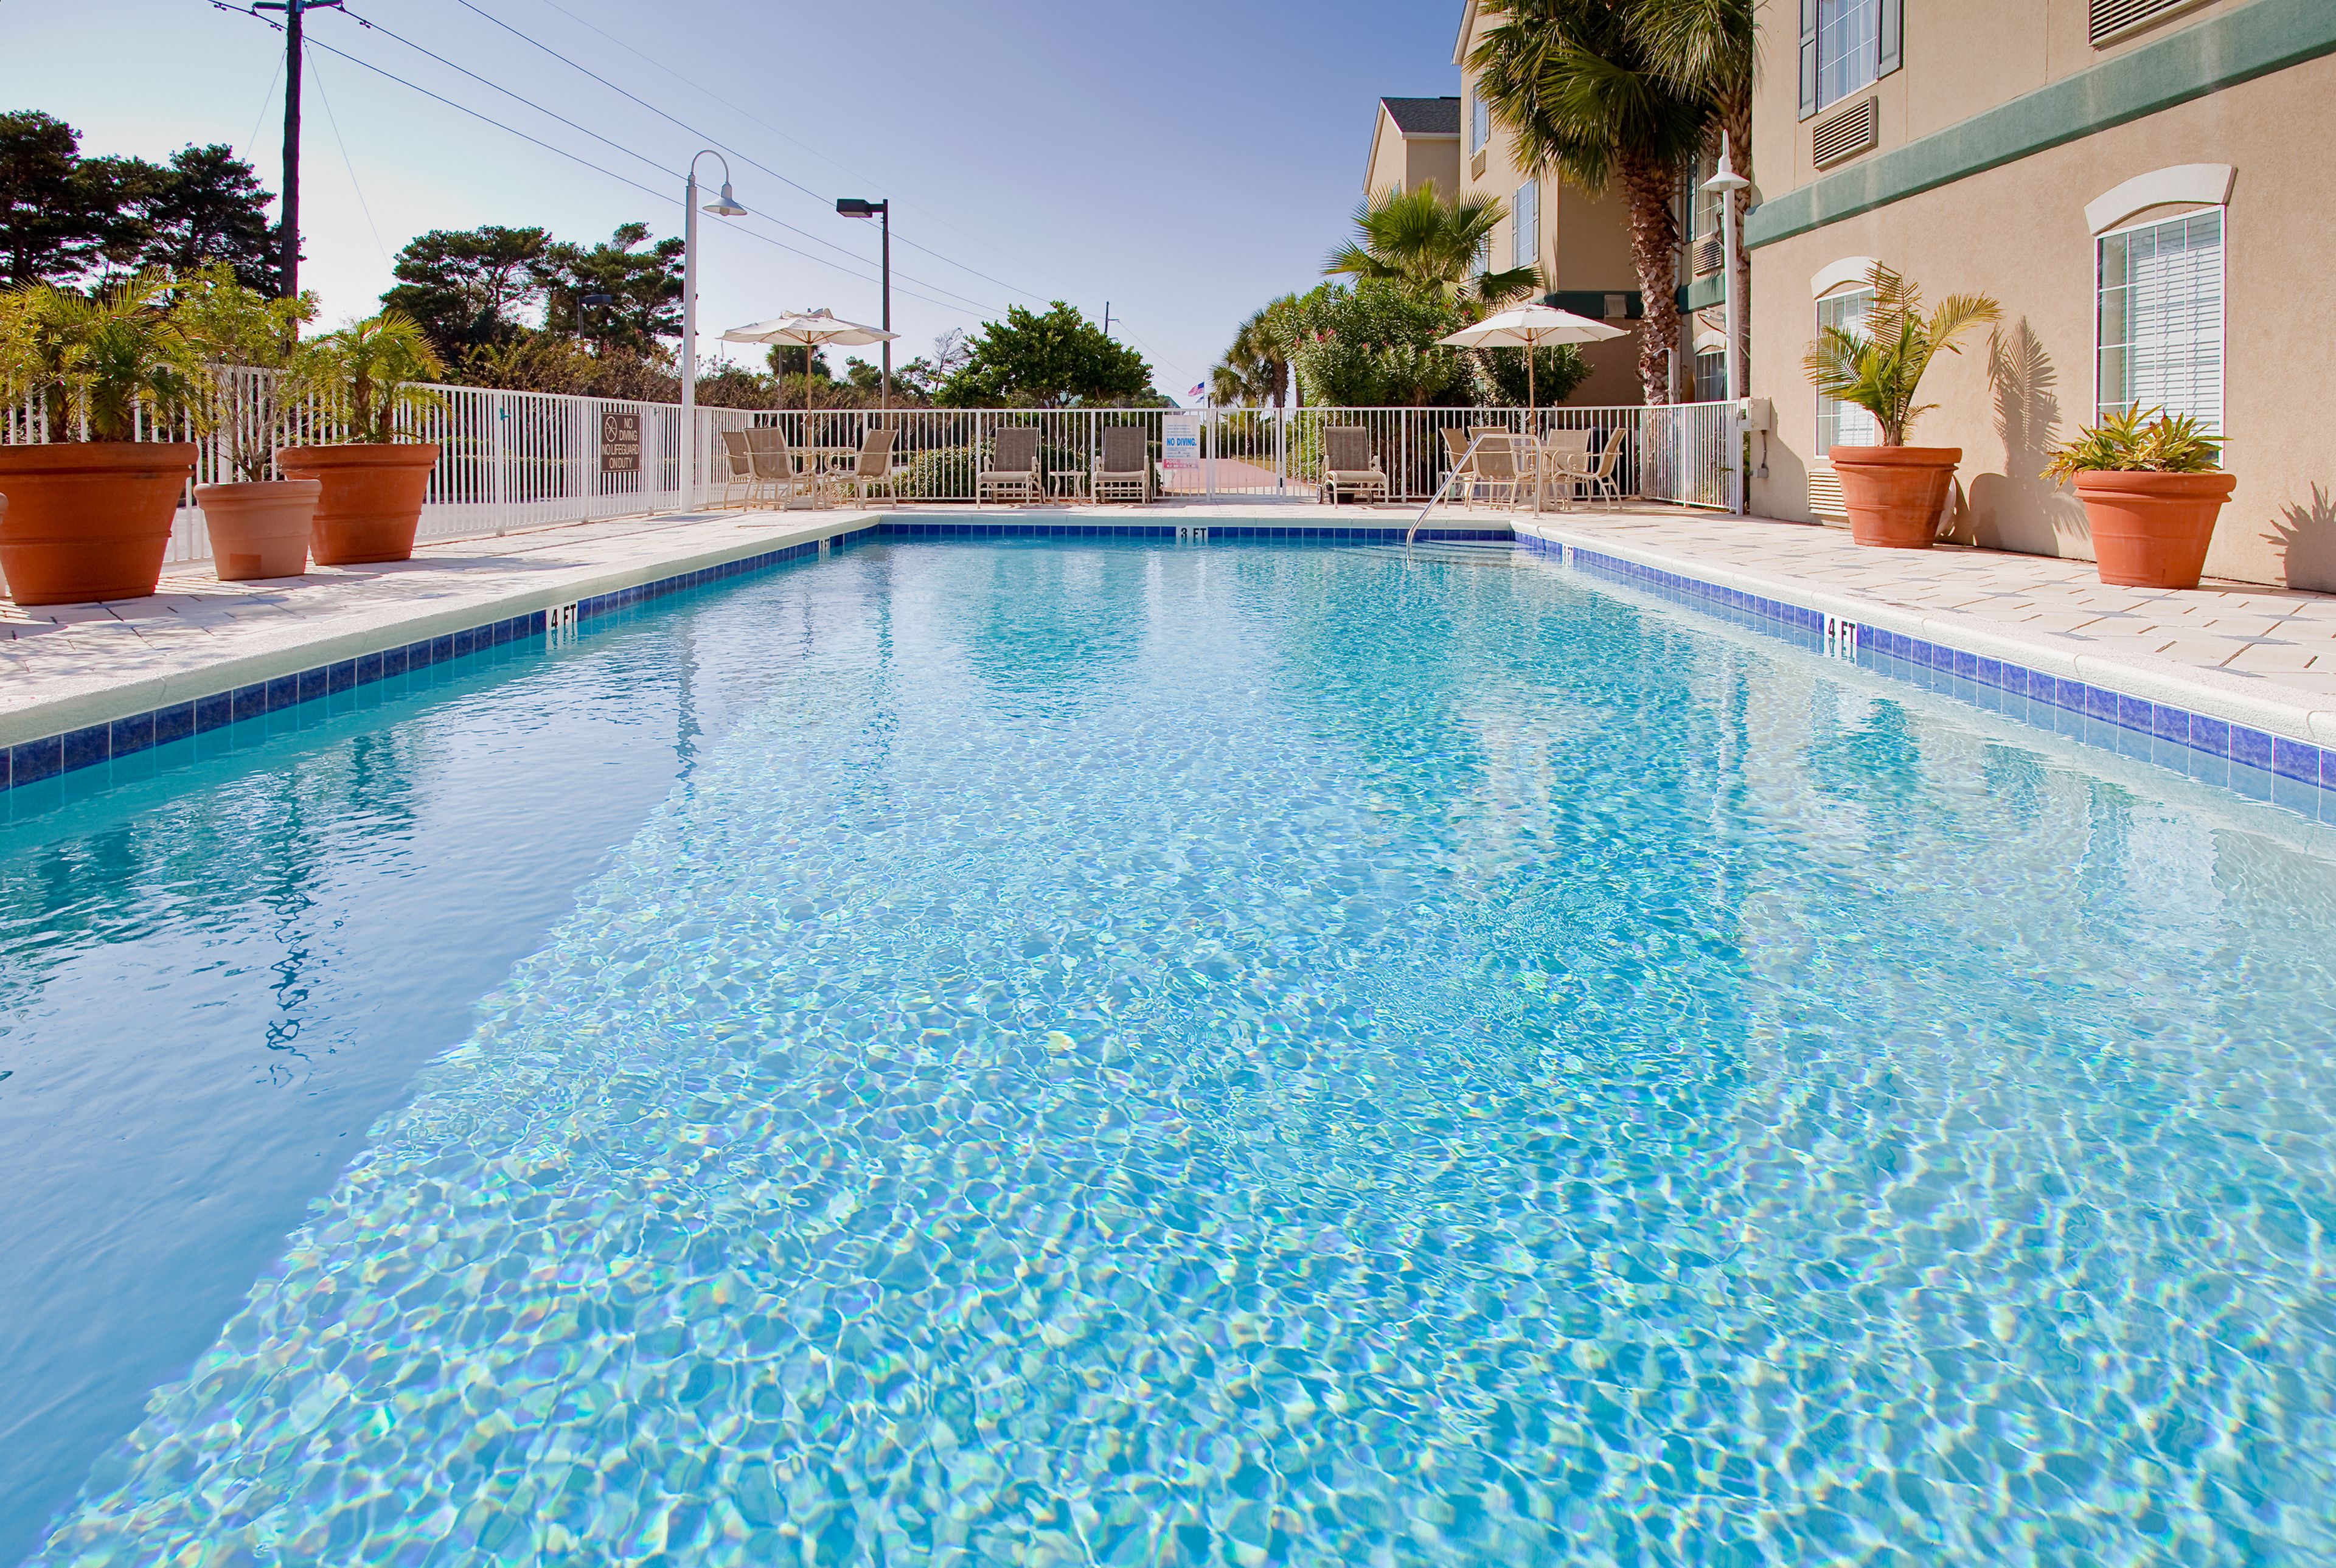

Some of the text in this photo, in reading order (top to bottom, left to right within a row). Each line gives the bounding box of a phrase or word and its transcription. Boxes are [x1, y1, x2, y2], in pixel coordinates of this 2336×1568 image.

[624, 418, 633, 429] NO
[619, 430, 638, 441] DIVING
[602, 444, 639, 456] NO LIFEGUARD
[609, 457, 633, 468] ON DUTY
[1181, 527, 1206, 538] 3 FT
[551, 604, 576, 628] 4 FT
[1829, 618, 1855, 643] 4 FT
